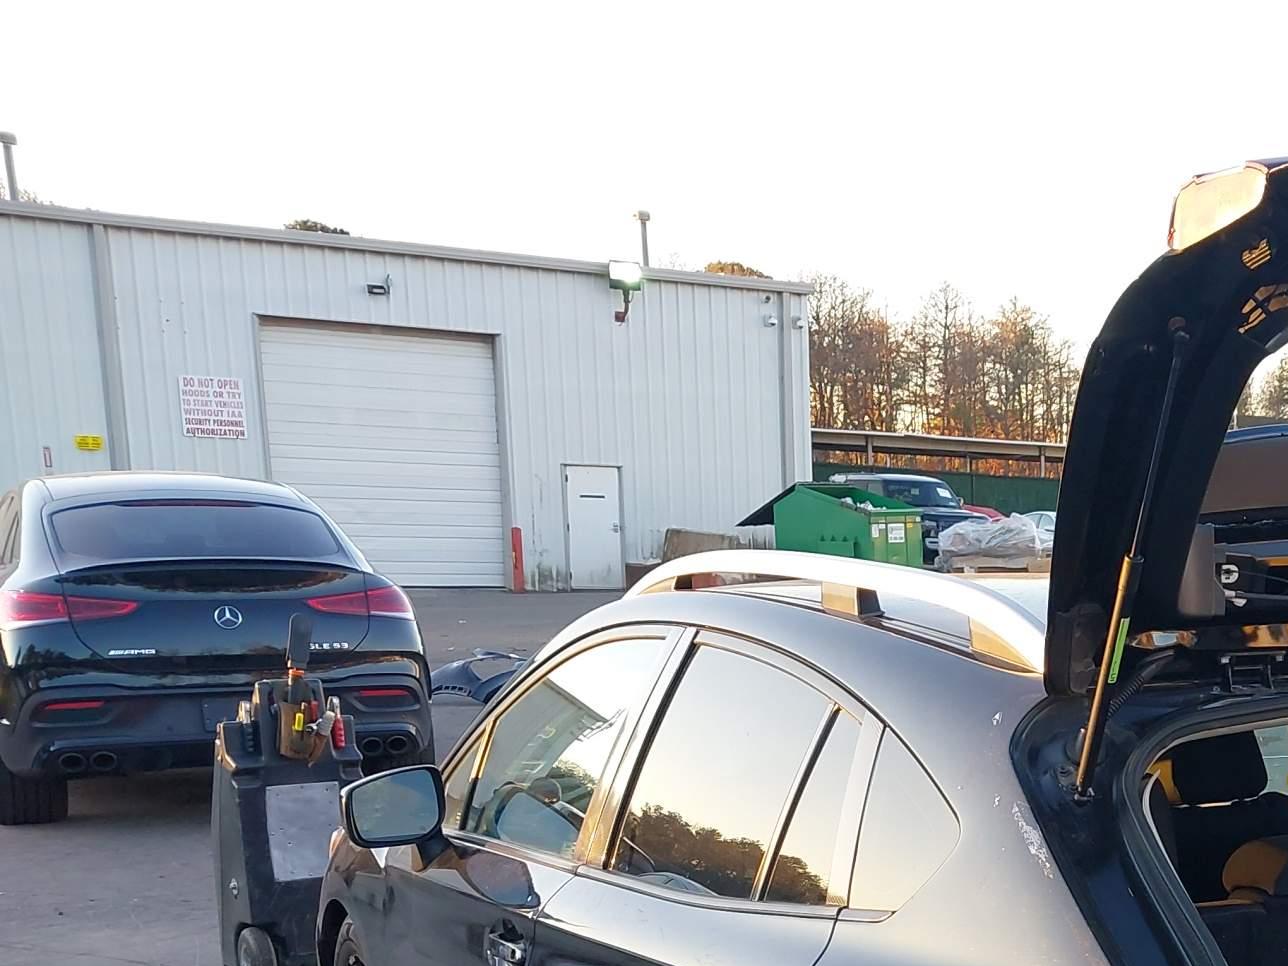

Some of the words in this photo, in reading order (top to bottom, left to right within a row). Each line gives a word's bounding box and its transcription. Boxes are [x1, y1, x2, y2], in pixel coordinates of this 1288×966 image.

[183, 377, 194, 387] DO
[198, 378, 214, 389] NOT
[217, 379, 240, 390] OPEN
[182, 389, 210, 397] HOODS
[213, 390, 224, 398] OR
[226, 391, 241, 399] TRY
[182, 399, 191, 407] TO
[193, 399, 212, 407] START
[215, 400, 243, 409] VEHICLES
[183, 408, 224, 417] WITHOUT
[227, 410, 243, 418] IAA
[185, 417, 211, 426] SECURITY
[213, 418, 244, 427] PERSONNEL
[186, 427, 245, 437] AUTHORIZATION
